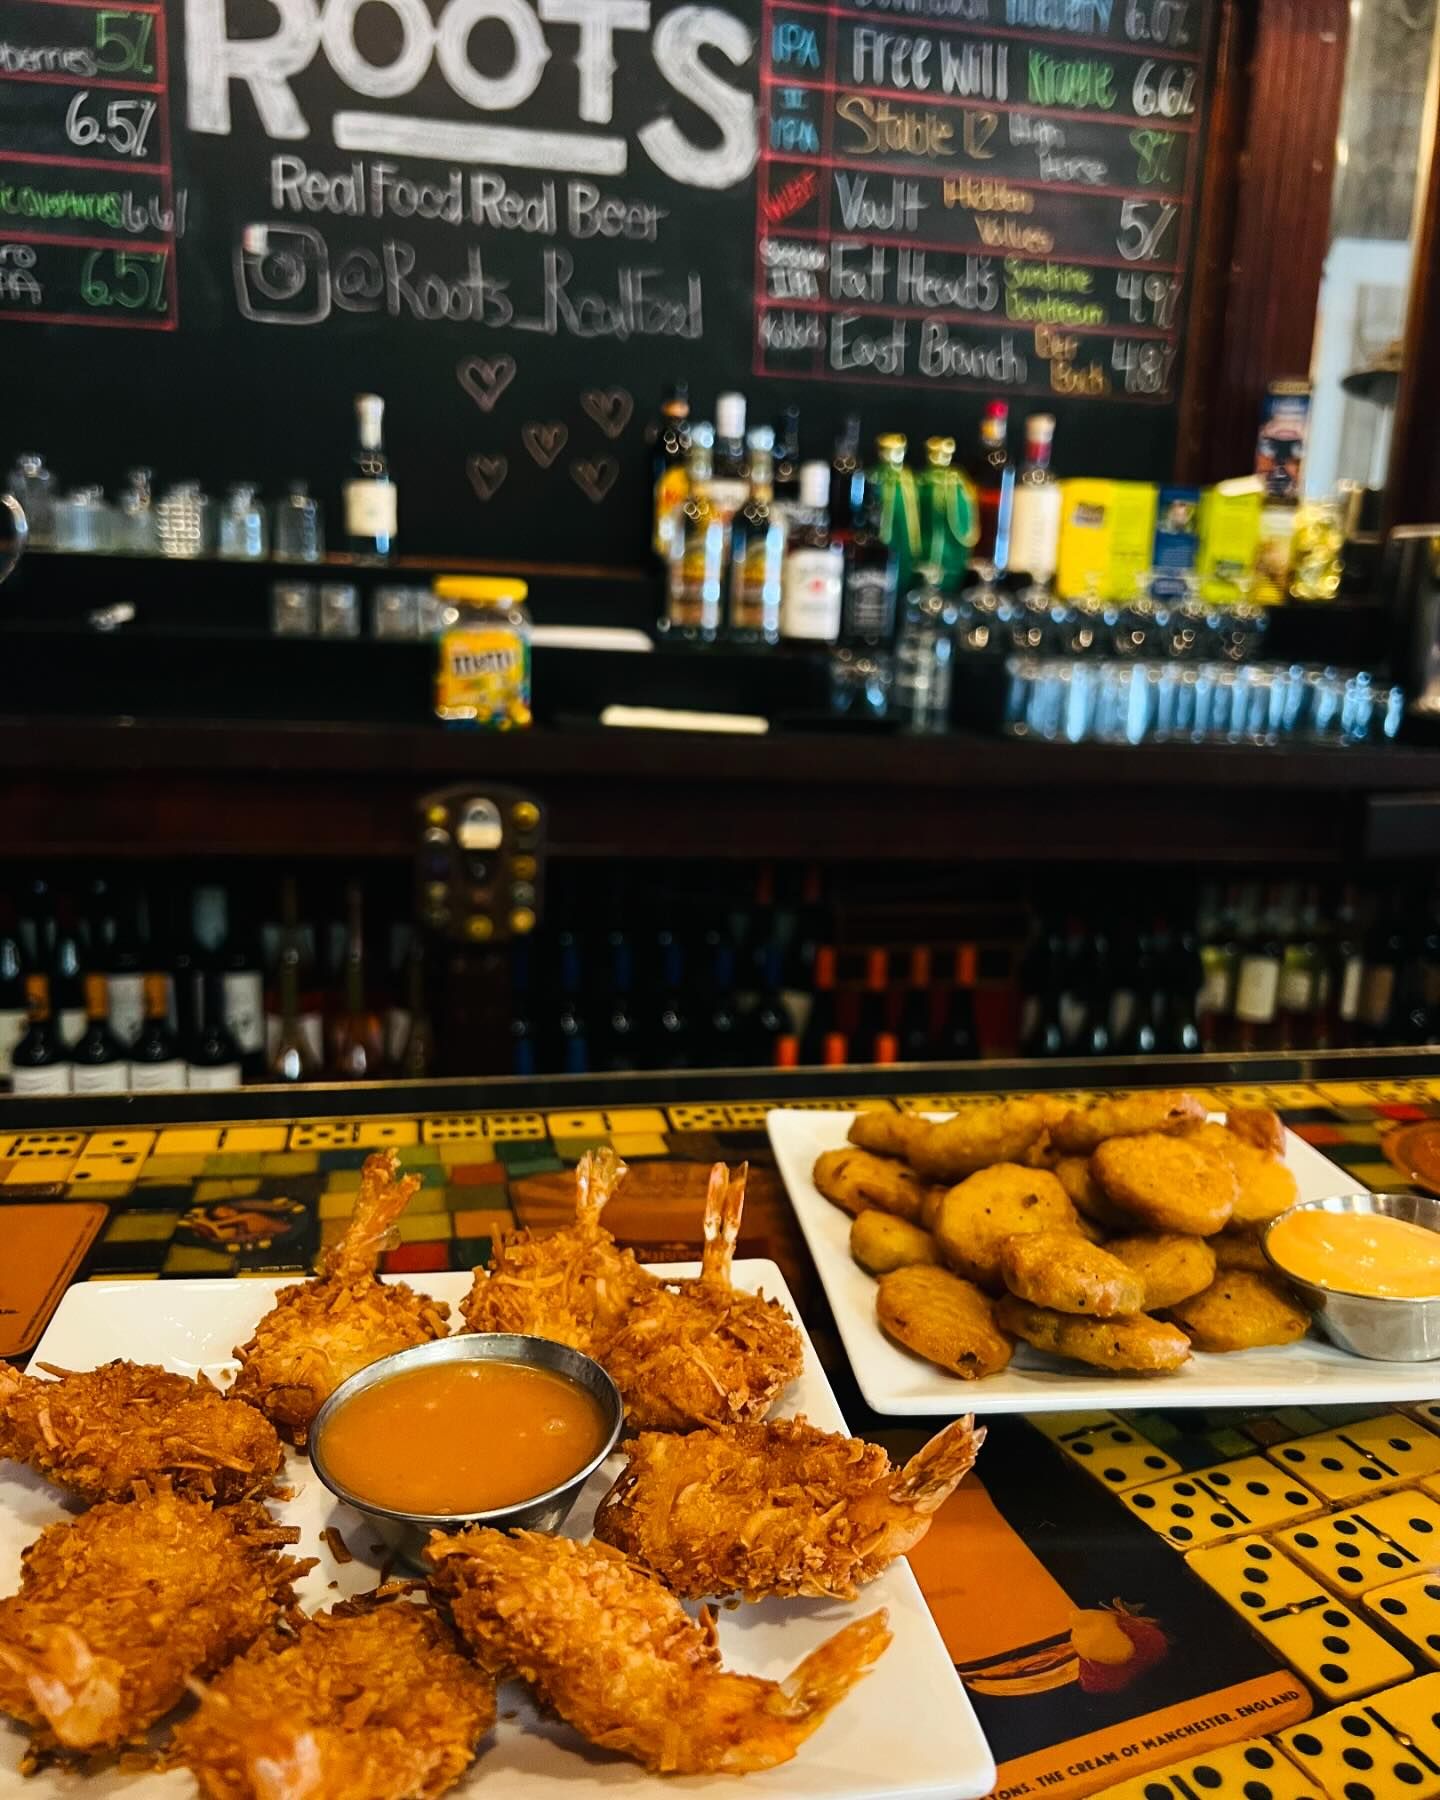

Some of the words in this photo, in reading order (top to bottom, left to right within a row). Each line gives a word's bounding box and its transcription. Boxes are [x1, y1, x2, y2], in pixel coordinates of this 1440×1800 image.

[184, 0, 758, 189] ROOTS
[771, 23, 821, 69] IPA
[853, 27, 932, 90] Free
[940, 39, 1008, 102] Will
[271, 155, 363, 216] Real
[370, 160, 461, 226] Food
[469, 172, 557, 236] Real
[567, 179, 670, 242] Beer
[834, 171, 930, 231] Vault
[829, 240, 890, 303] Fat
[830, 310, 907, 376] East
[979, 1782, 1036, 1800] TONS.
[1036, 1771, 1065, 1788] THE
[1067, 1751, 1119, 1776] CREAM
[1121, 1744, 1140, 1757] OF
[1236, 1690, 1300, 1718] ENGLAND
